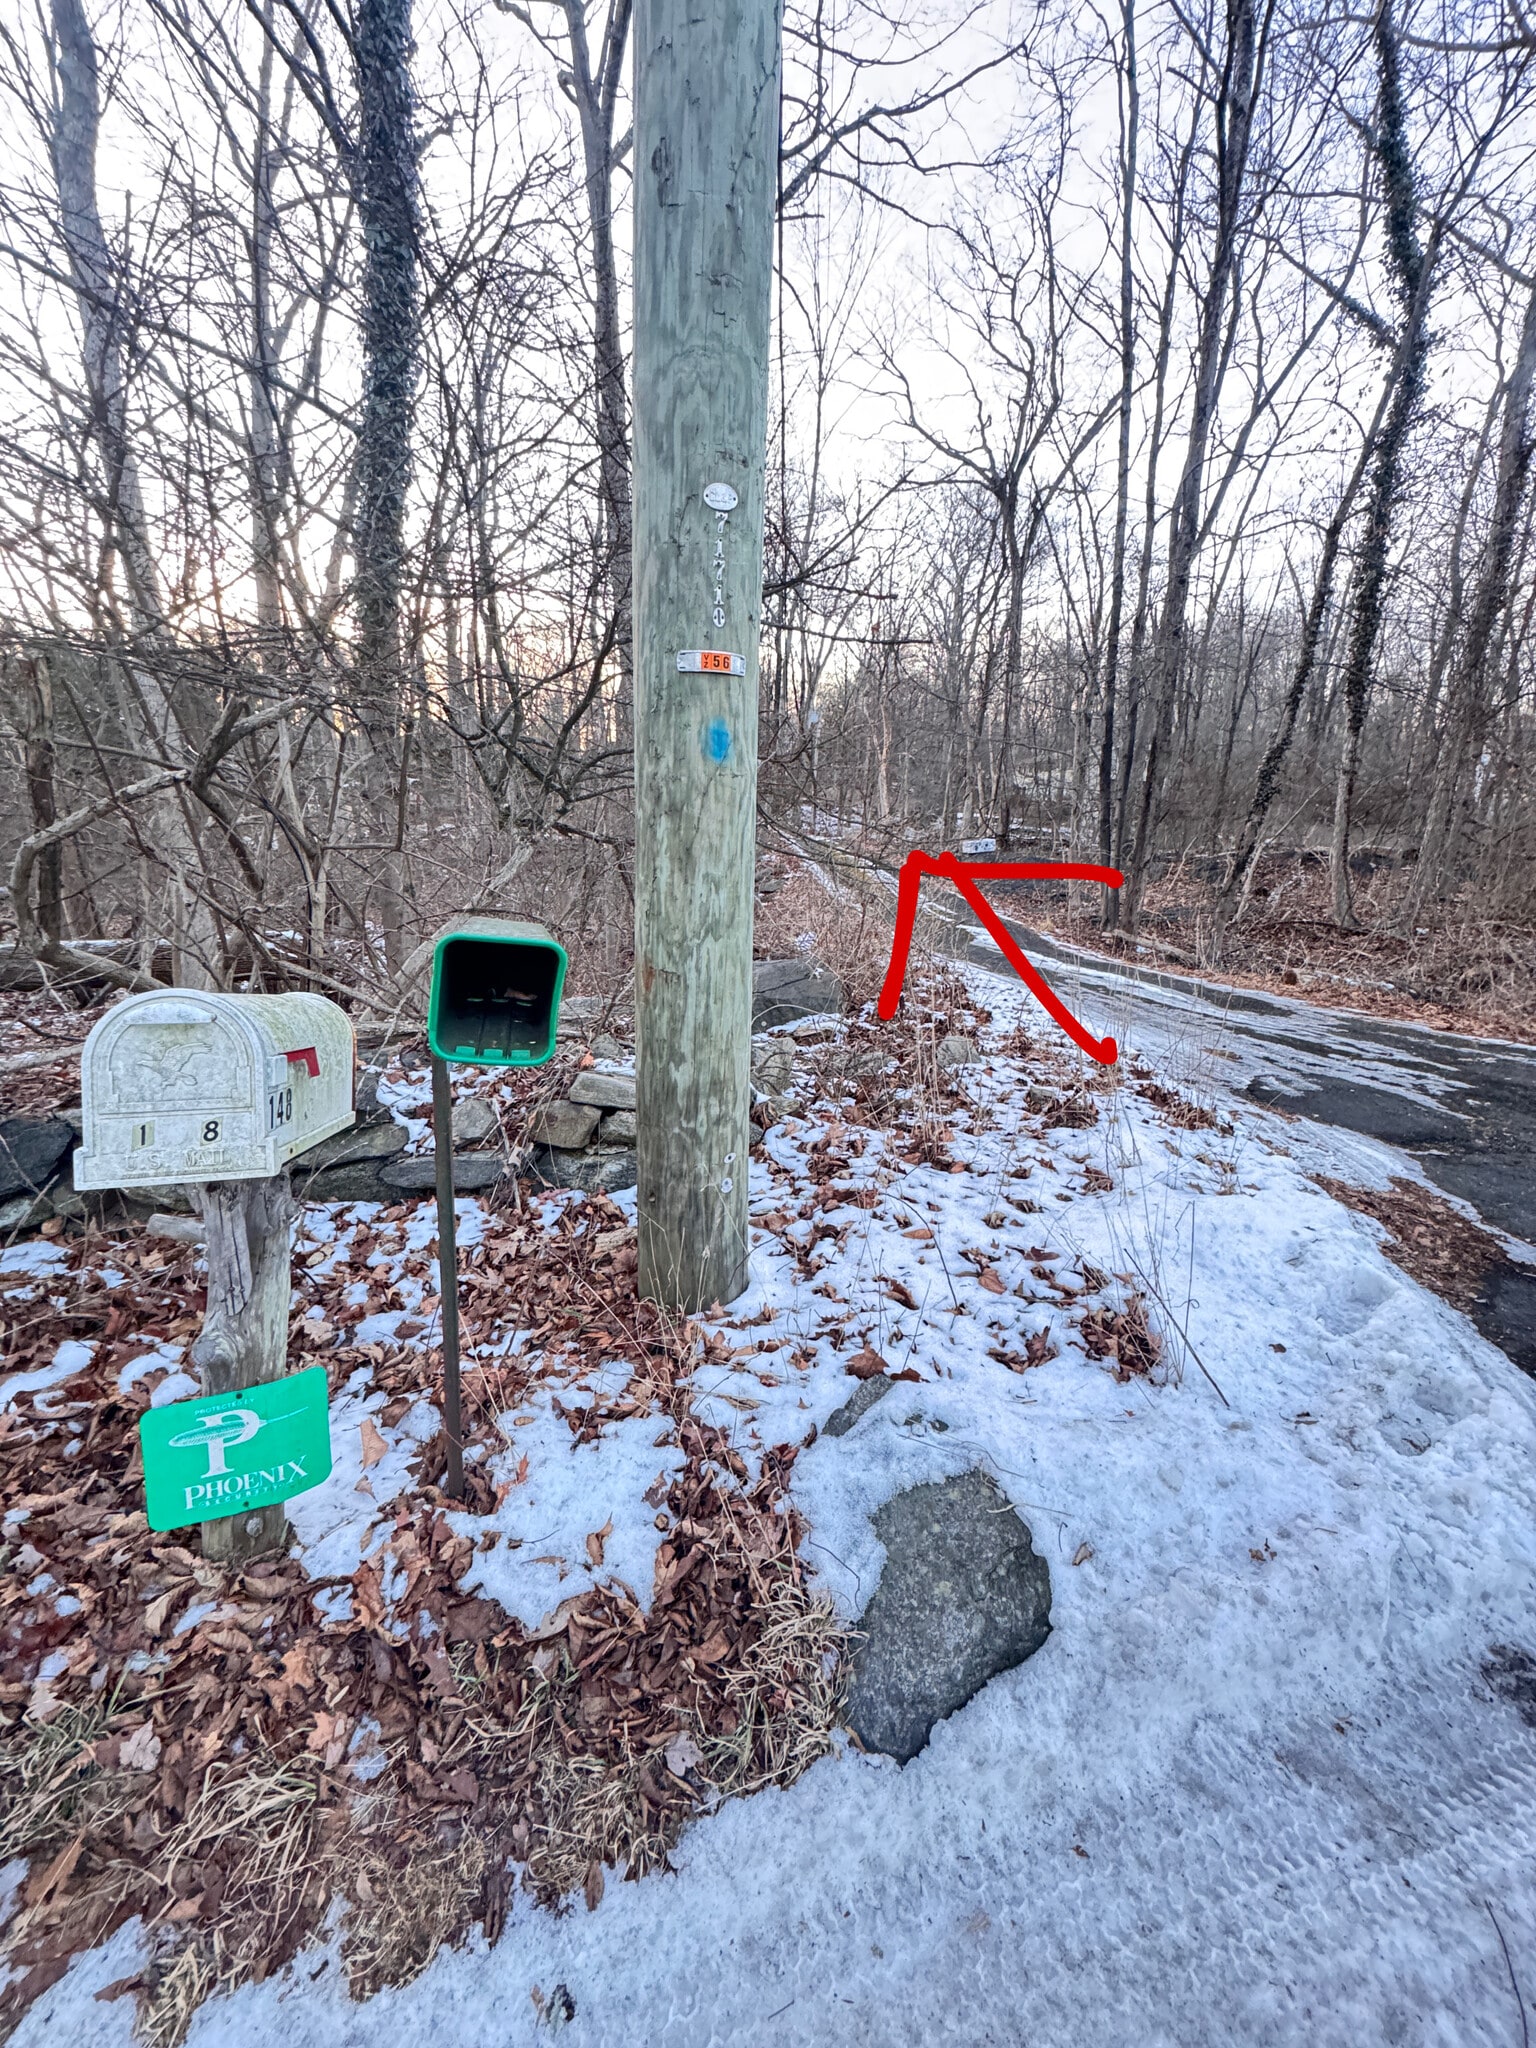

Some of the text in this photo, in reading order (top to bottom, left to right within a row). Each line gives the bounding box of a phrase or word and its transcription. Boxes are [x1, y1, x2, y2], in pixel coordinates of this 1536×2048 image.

[713, 655, 730, 669] 56
[269, 1088, 292, 1129] 148
[139, 1120, 219, 1146] 1 8
[124, 1148, 230, 1172] U.S. MAIL
[183, 1454, 308, 1510] PHOENIX
[204, 1484, 278, 1507] SECURITY
